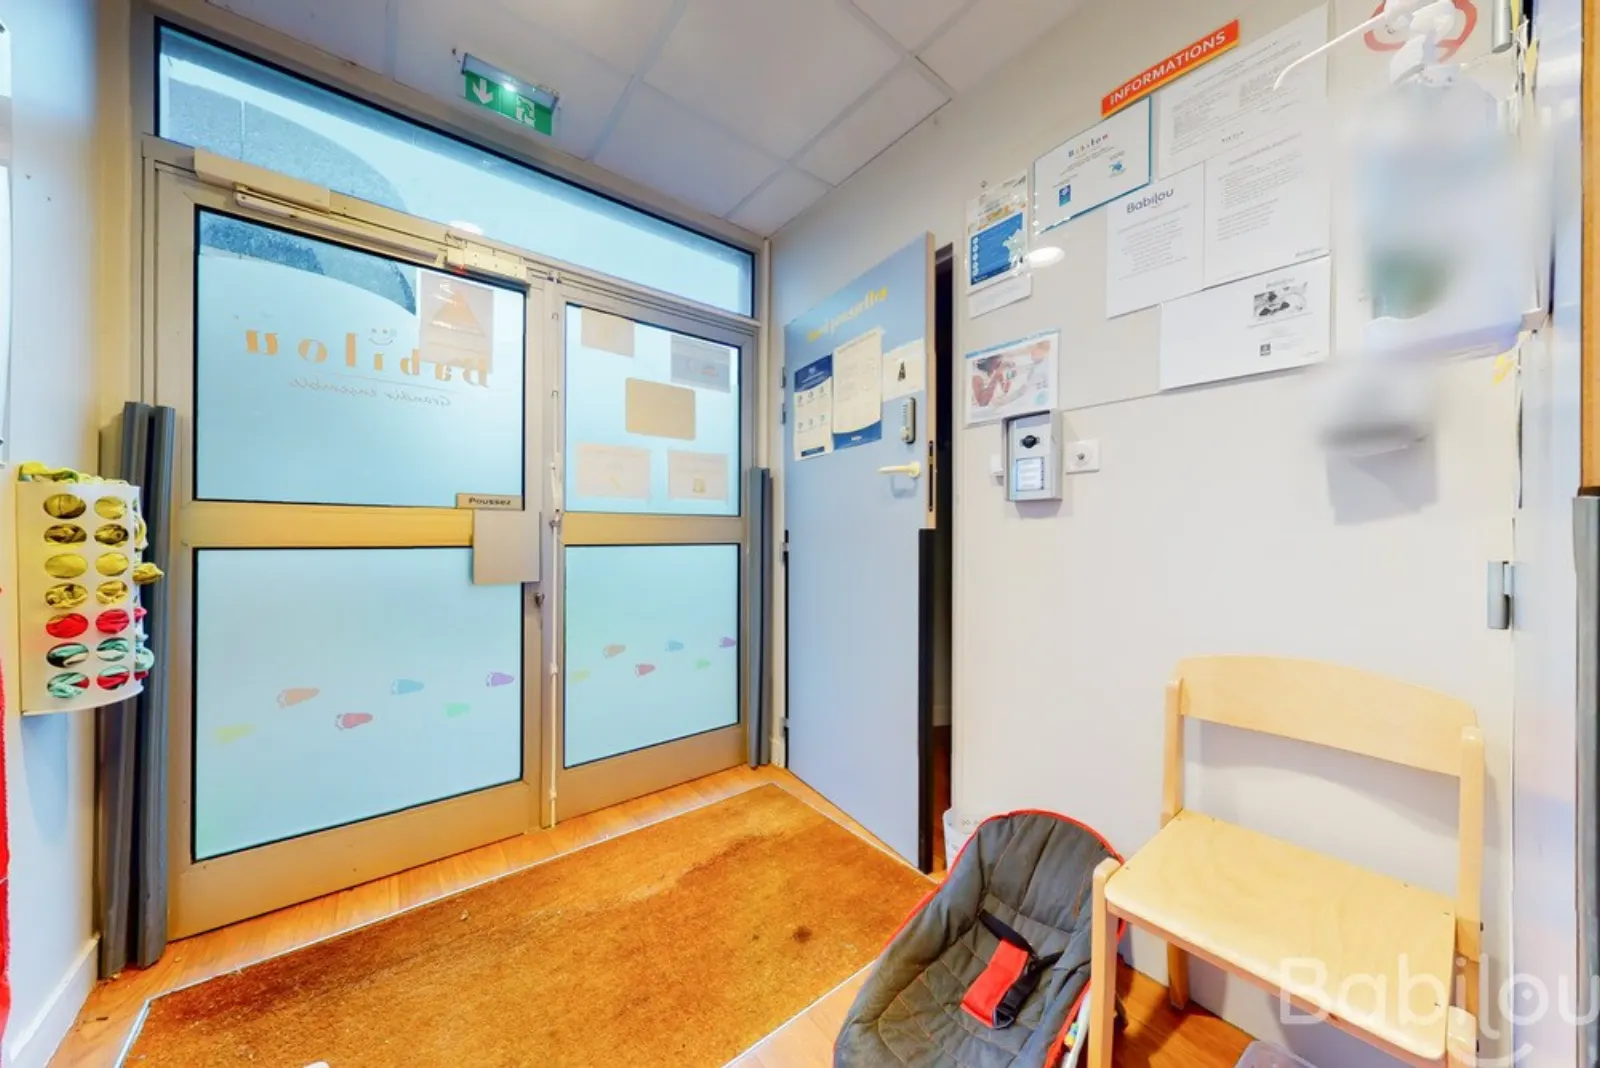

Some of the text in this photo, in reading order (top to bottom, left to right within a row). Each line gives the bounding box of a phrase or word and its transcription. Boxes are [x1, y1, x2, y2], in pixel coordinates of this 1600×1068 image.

[1110, 32, 1226, 105] INFORMATIONS
[1126, 187, 1175, 214] Babilou
[468, 497, 511, 505] Poussez
